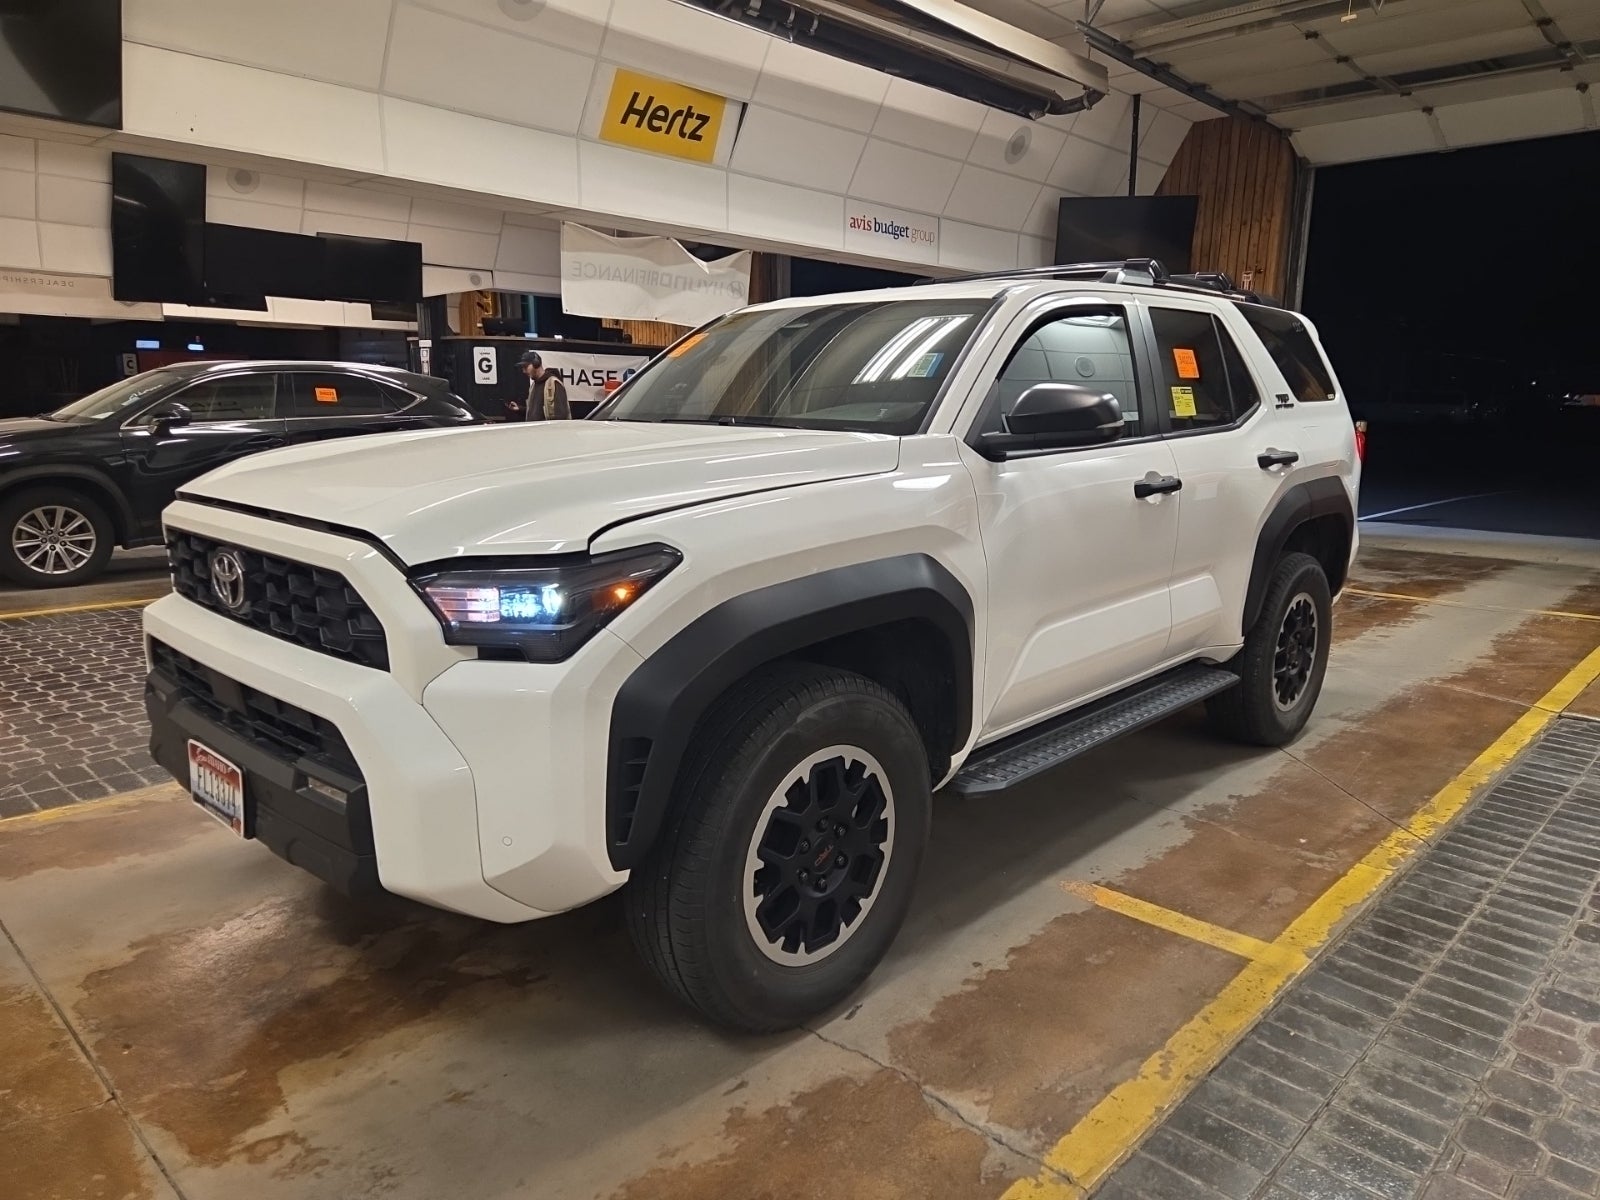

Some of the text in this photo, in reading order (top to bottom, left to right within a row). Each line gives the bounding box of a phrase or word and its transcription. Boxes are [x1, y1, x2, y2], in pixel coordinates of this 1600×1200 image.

[620, 91, 711, 142] Hertz
[849, 214, 936, 246] avis budget group
[478, 357, 493, 374] G
[560, 367, 618, 387] HASE
